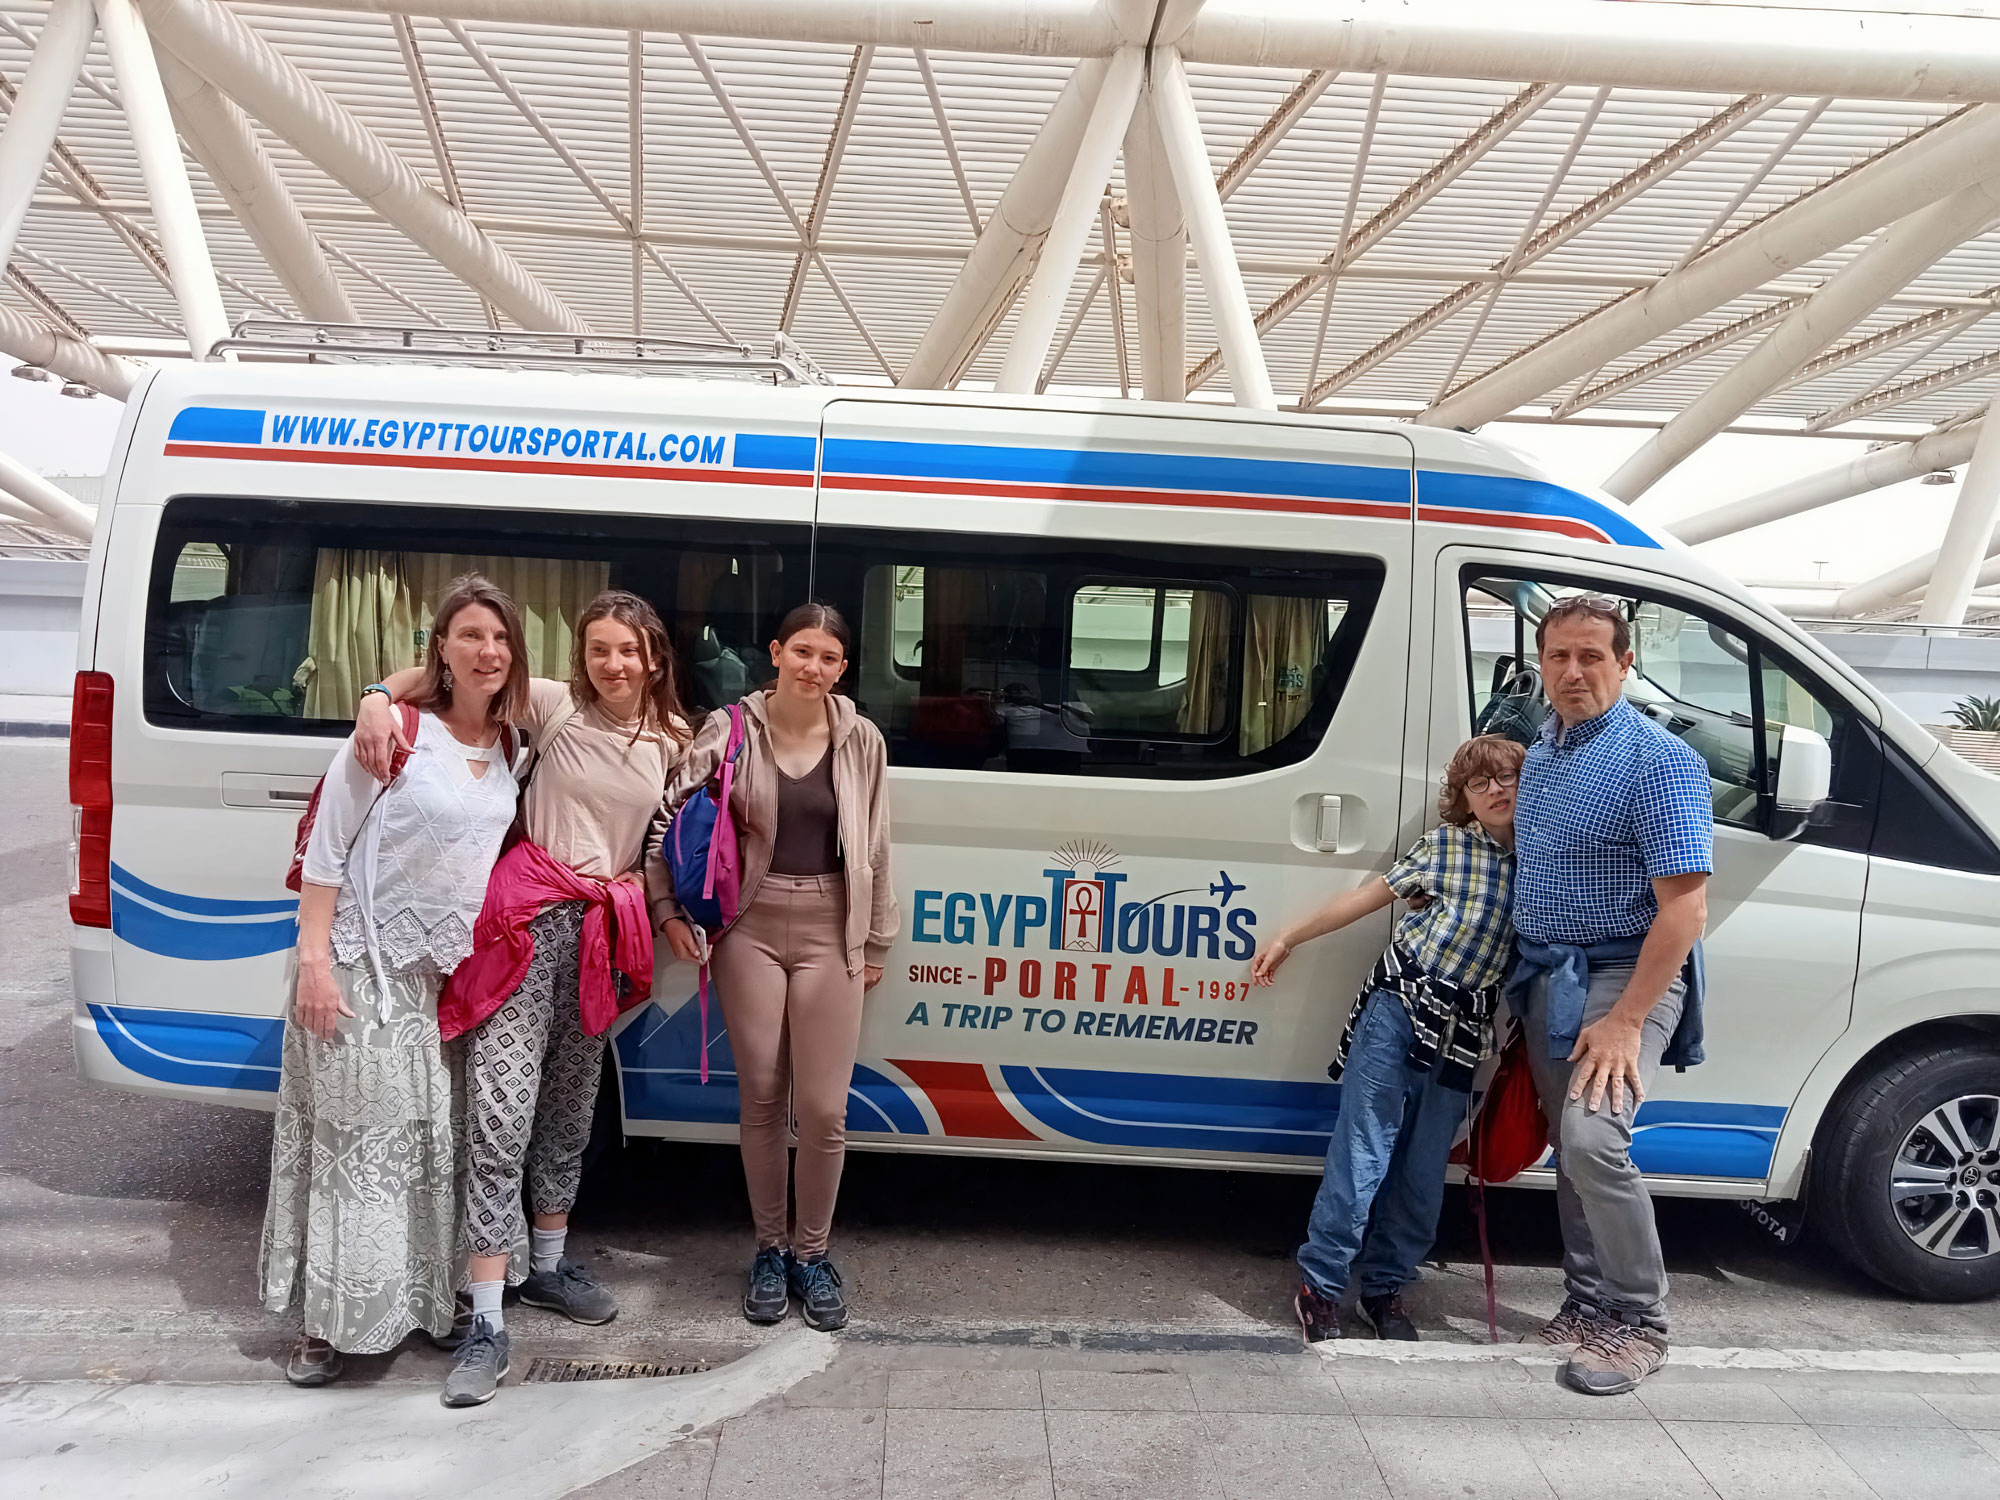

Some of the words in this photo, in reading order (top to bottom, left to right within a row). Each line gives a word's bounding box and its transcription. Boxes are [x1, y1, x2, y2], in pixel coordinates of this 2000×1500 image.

[272, 414, 726, 464] WWW.EGYPTTOURSPORTAL.COM
[912, 869, 1076, 950] EGYPT
[1094, 872, 1257, 961] TOURS
[983, 957, 1180, 1007] PORTAL
[905, 1001, 929, 1026] A
[942, 1003, 1013, 1030] TRIP
[1022, 1007, 1066, 1034] TO
[1073, 1011, 1258, 1046] REMEMBER
[1740, 1199, 1787, 1241] OYOTA
